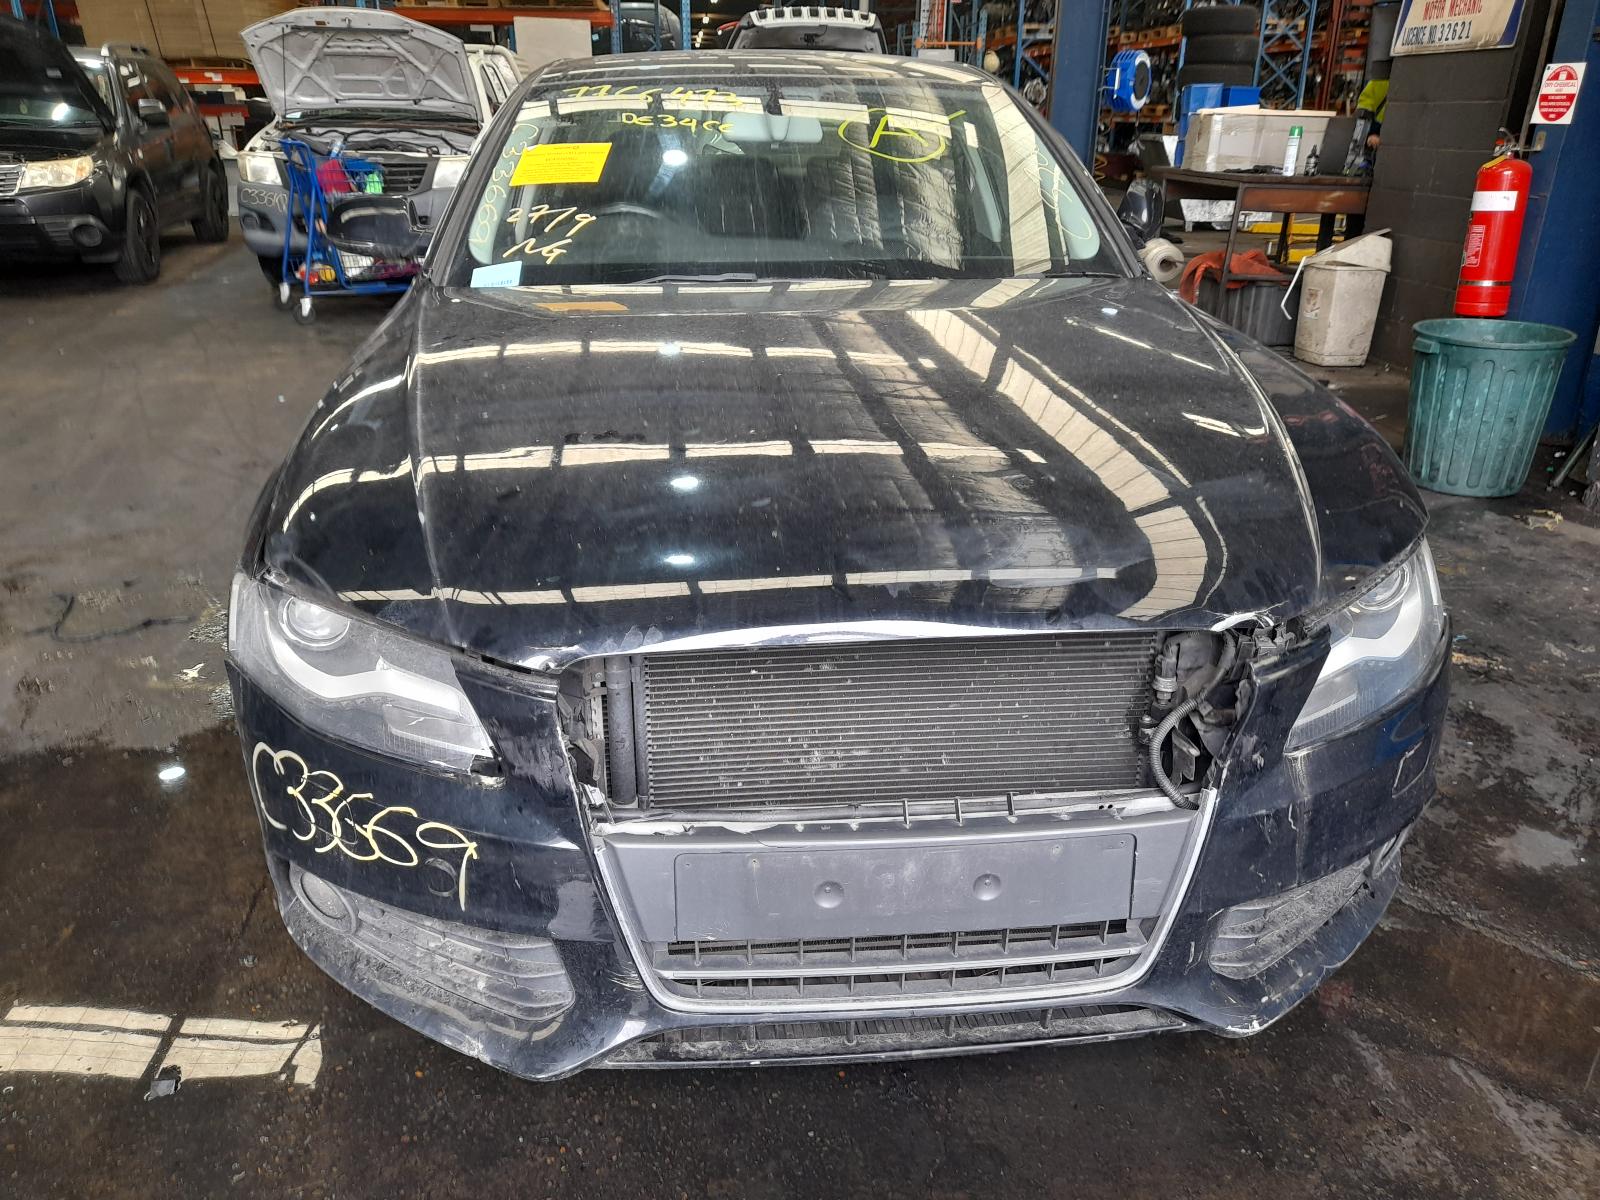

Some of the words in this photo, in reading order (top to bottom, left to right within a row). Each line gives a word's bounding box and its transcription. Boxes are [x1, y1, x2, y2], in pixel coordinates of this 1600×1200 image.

[1423, 0, 1446, 21] MOTOR
[1448, 0, 1482, 17] MECHANIC
[1402, 25, 1427, 46] LICENCE
[1437, 20, 1472, 42] 32621
[869, 113, 928, 149] A
[252, 741, 478, 912] C33669
